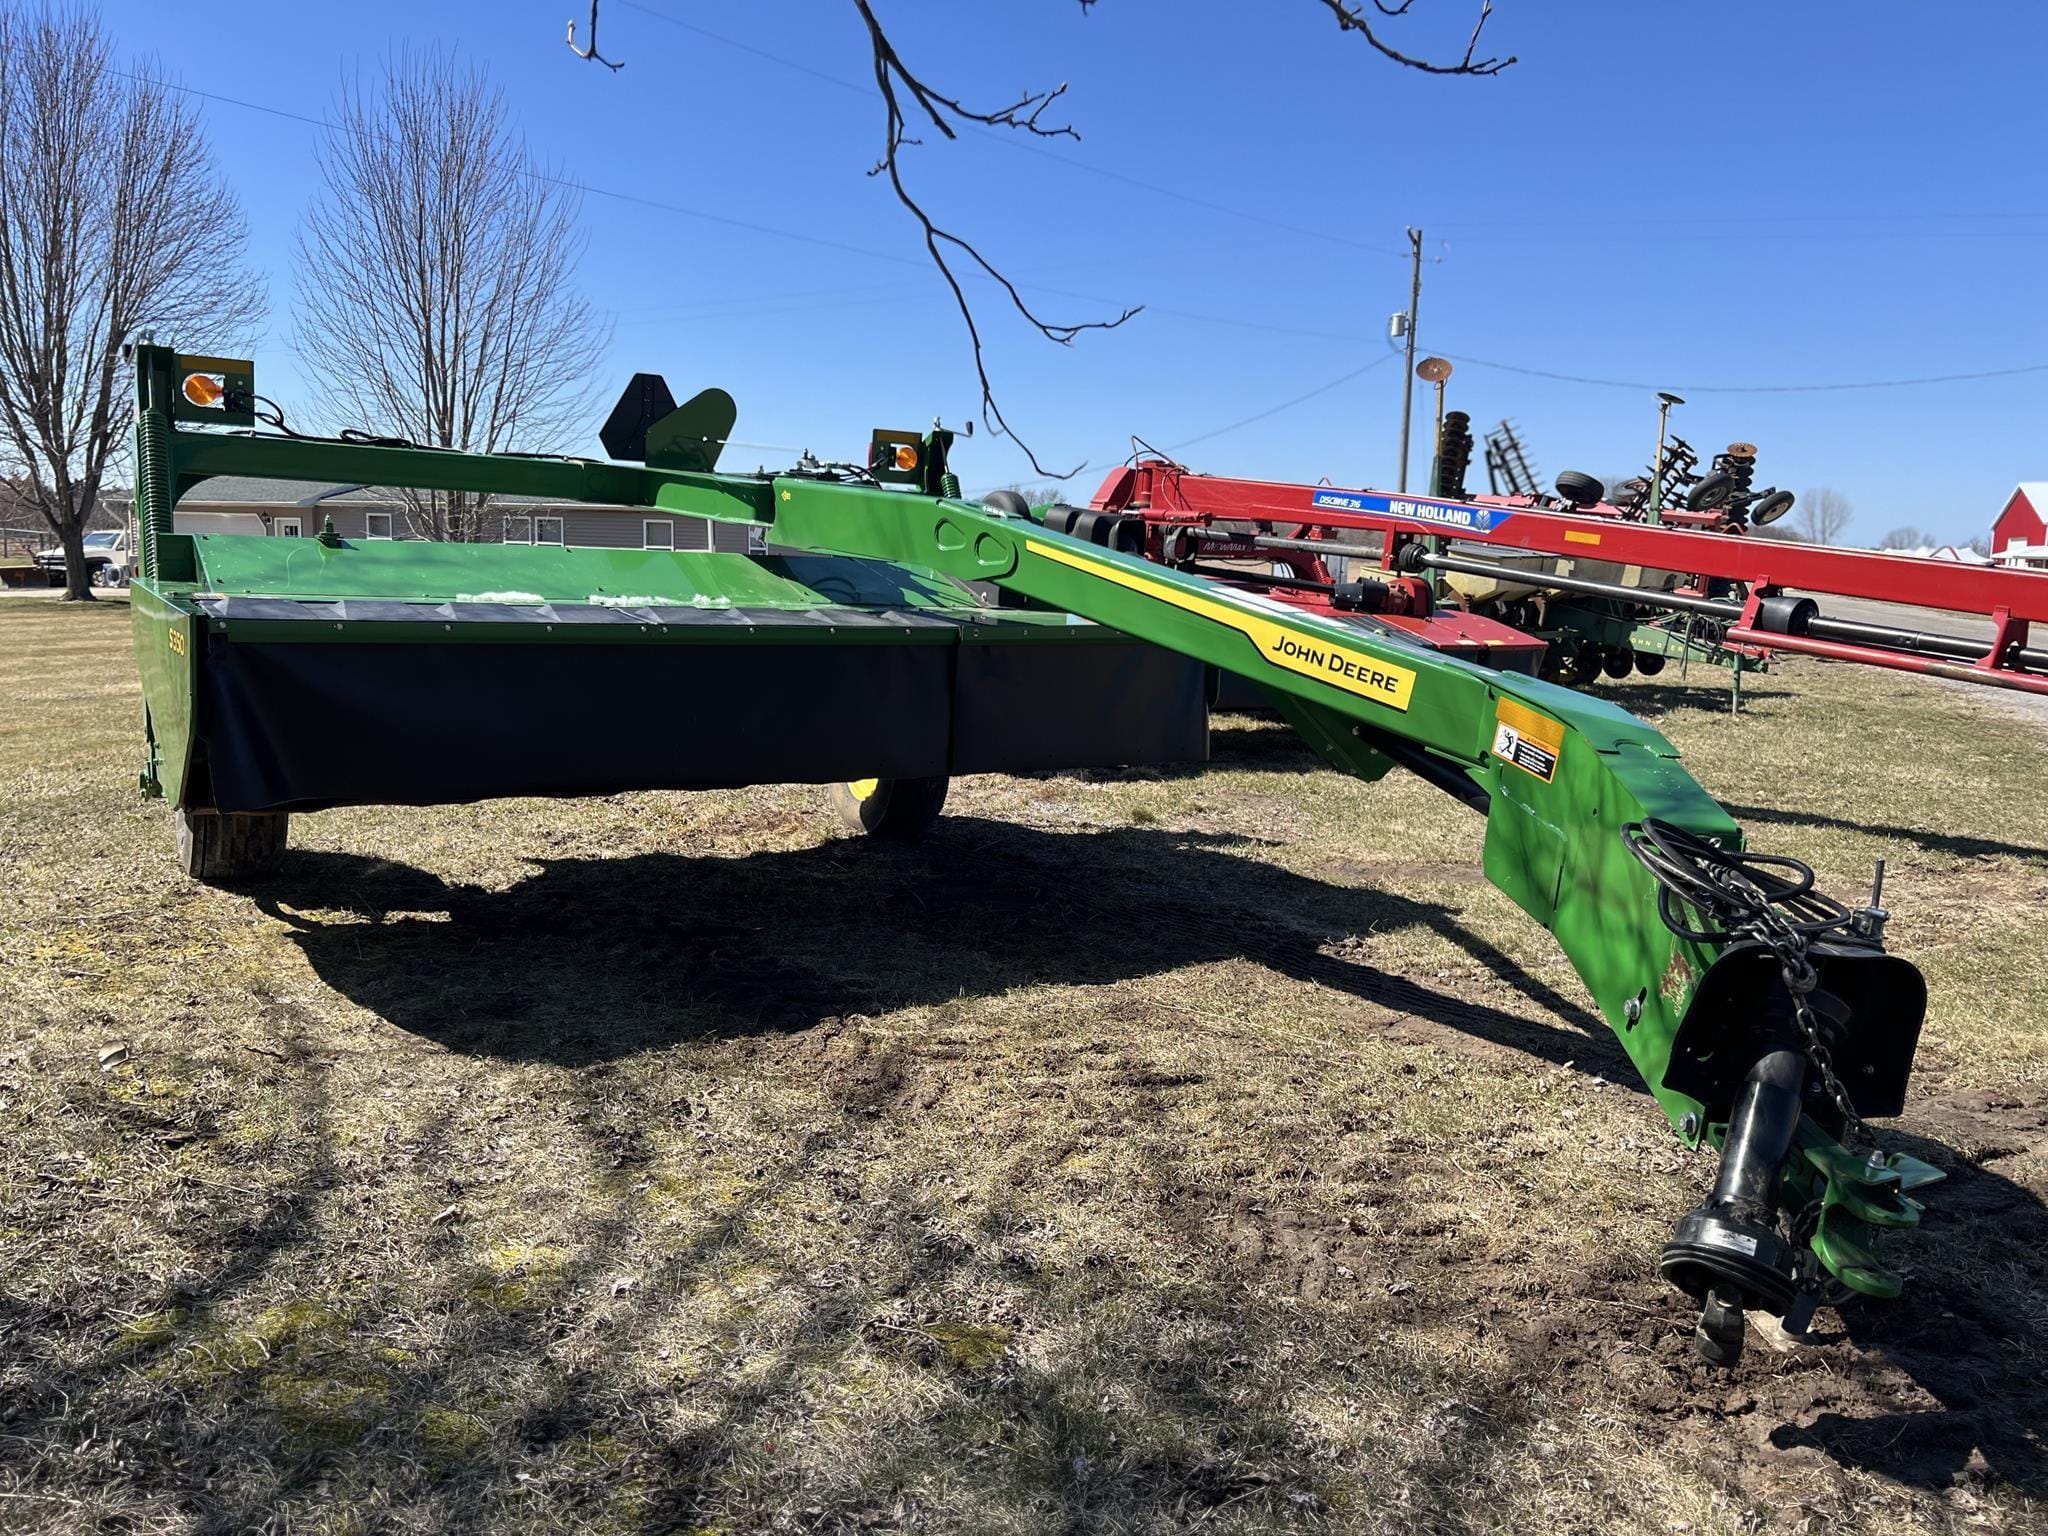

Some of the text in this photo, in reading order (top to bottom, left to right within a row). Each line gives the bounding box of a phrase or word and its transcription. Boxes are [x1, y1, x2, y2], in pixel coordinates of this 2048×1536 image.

[1389, 501, 1471, 525] NEW HOLLAND
[169, 628, 185, 656] S350
[1631, 637, 1651, 646] OHN
[1272, 636, 1399, 693] JOHN DEERE
